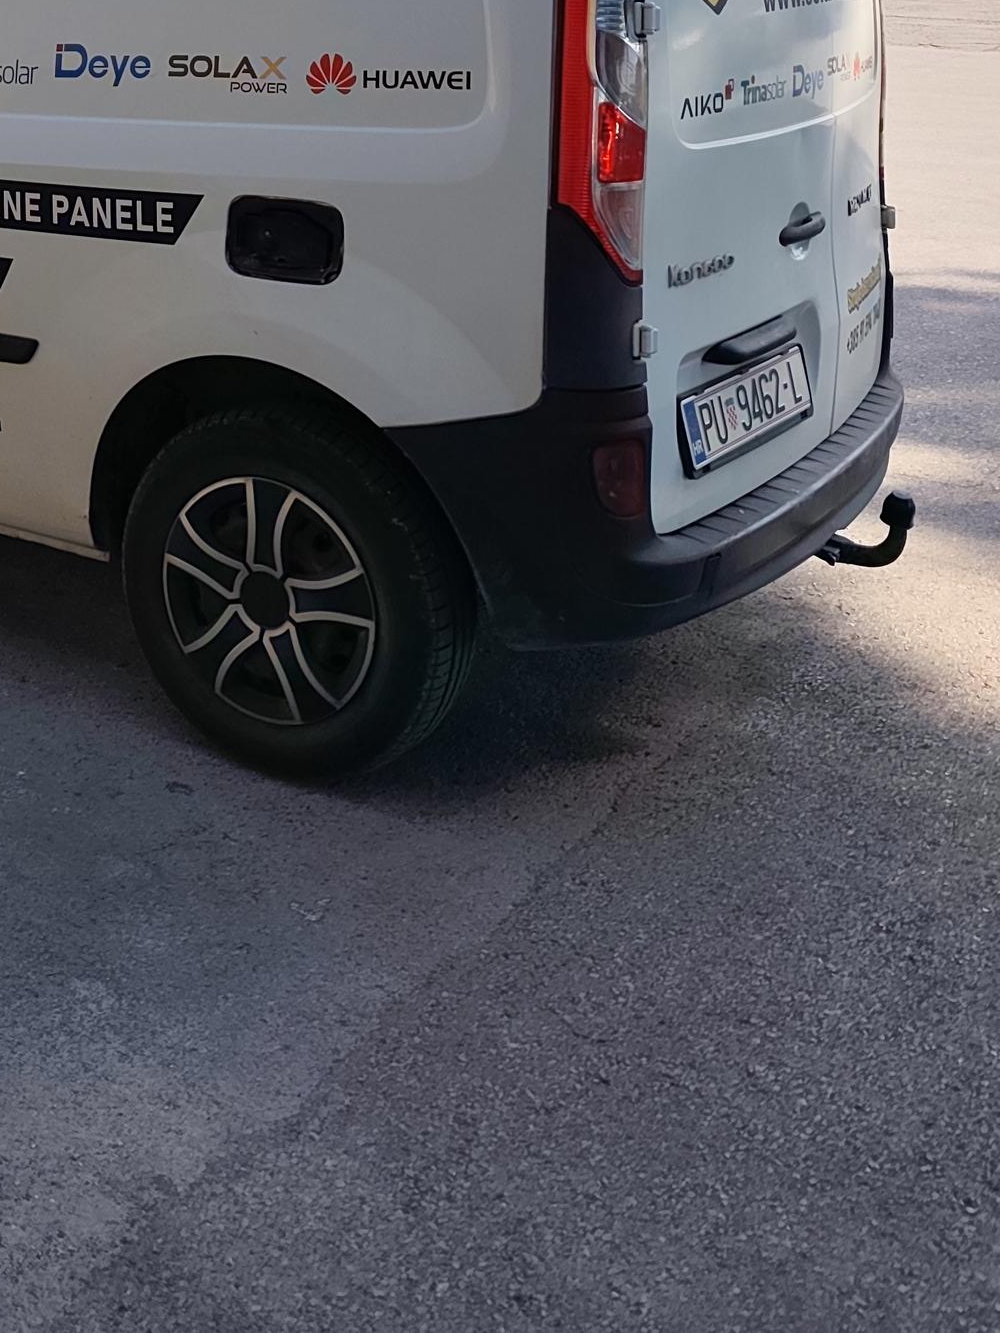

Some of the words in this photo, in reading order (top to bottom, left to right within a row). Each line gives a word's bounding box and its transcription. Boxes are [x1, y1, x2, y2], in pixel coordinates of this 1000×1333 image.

[55, 43, 151, 87] Deye
[168, 54, 287, 81] SOLAX
[362, 67, 471, 91] HUAWEI
[230, 80, 288, 95] POWER
[740, 75, 787, 106] Trinasolar
[792, 64, 824, 99] Deye
[680, 91, 724, 120] AIKO
[51, 195, 175, 234] PANELE
[699, 395, 729, 452] PU
[736, 361, 803, 432] 9462-L
